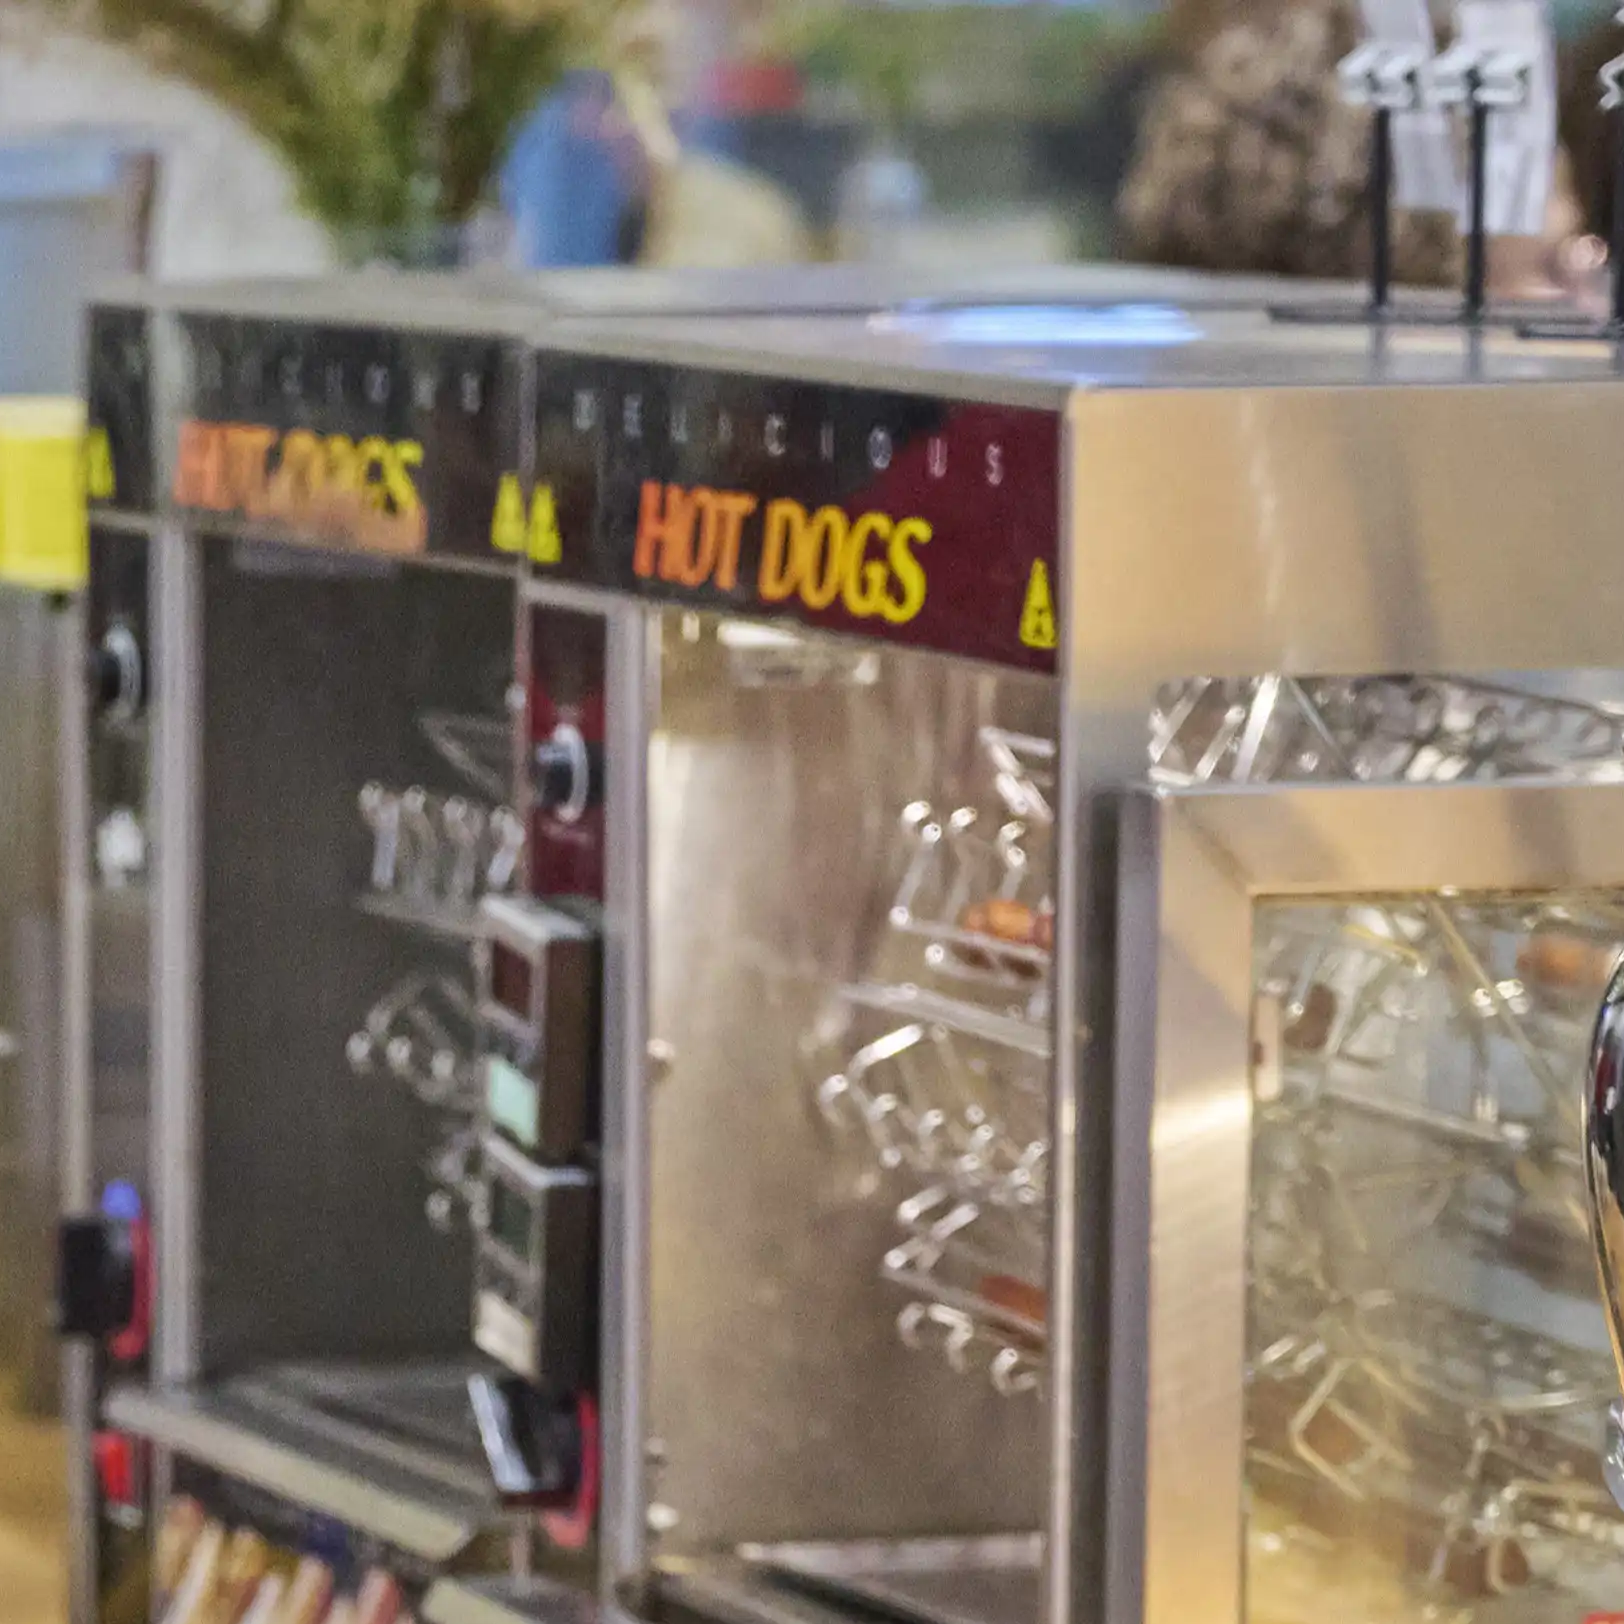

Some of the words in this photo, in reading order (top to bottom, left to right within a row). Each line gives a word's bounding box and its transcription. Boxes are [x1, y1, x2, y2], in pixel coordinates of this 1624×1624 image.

[174, 419, 280, 512] HOT
[572, 387, 1006, 488] DELICIOUS
[633, 478, 758, 591] HOT
[758, 497, 934, 624] DOGS
